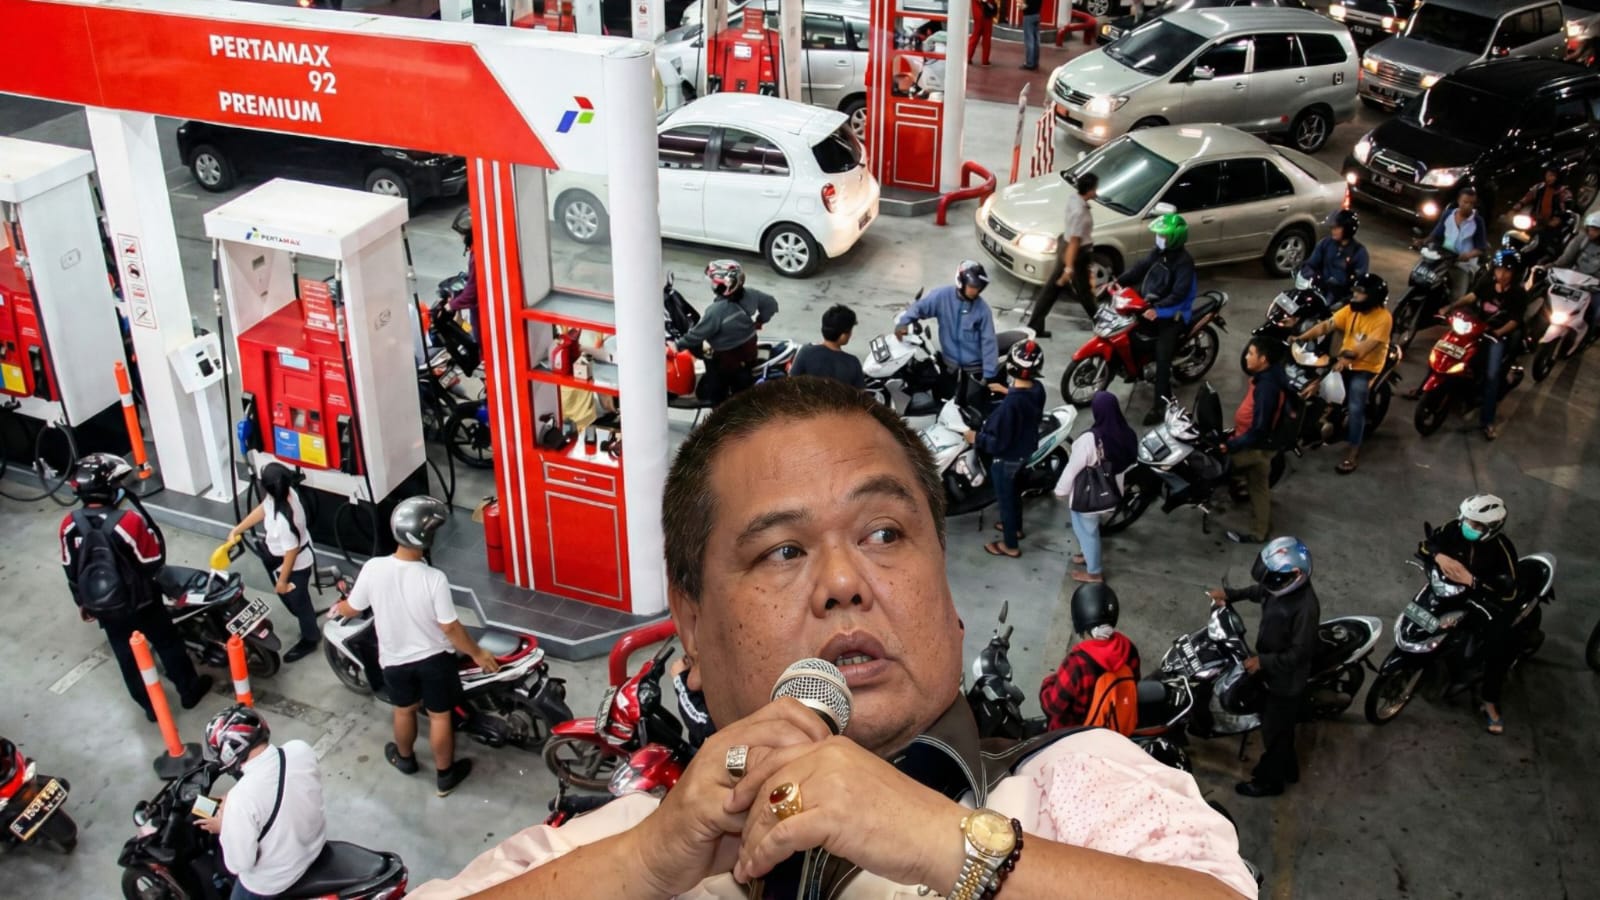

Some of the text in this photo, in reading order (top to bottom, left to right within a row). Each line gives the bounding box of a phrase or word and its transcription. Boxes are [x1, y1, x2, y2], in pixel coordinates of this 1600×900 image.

[209, 34, 332, 68] PERTAMAX
[308, 70, 337, 94] 92
[218, 90, 323, 123] PREMIUM
